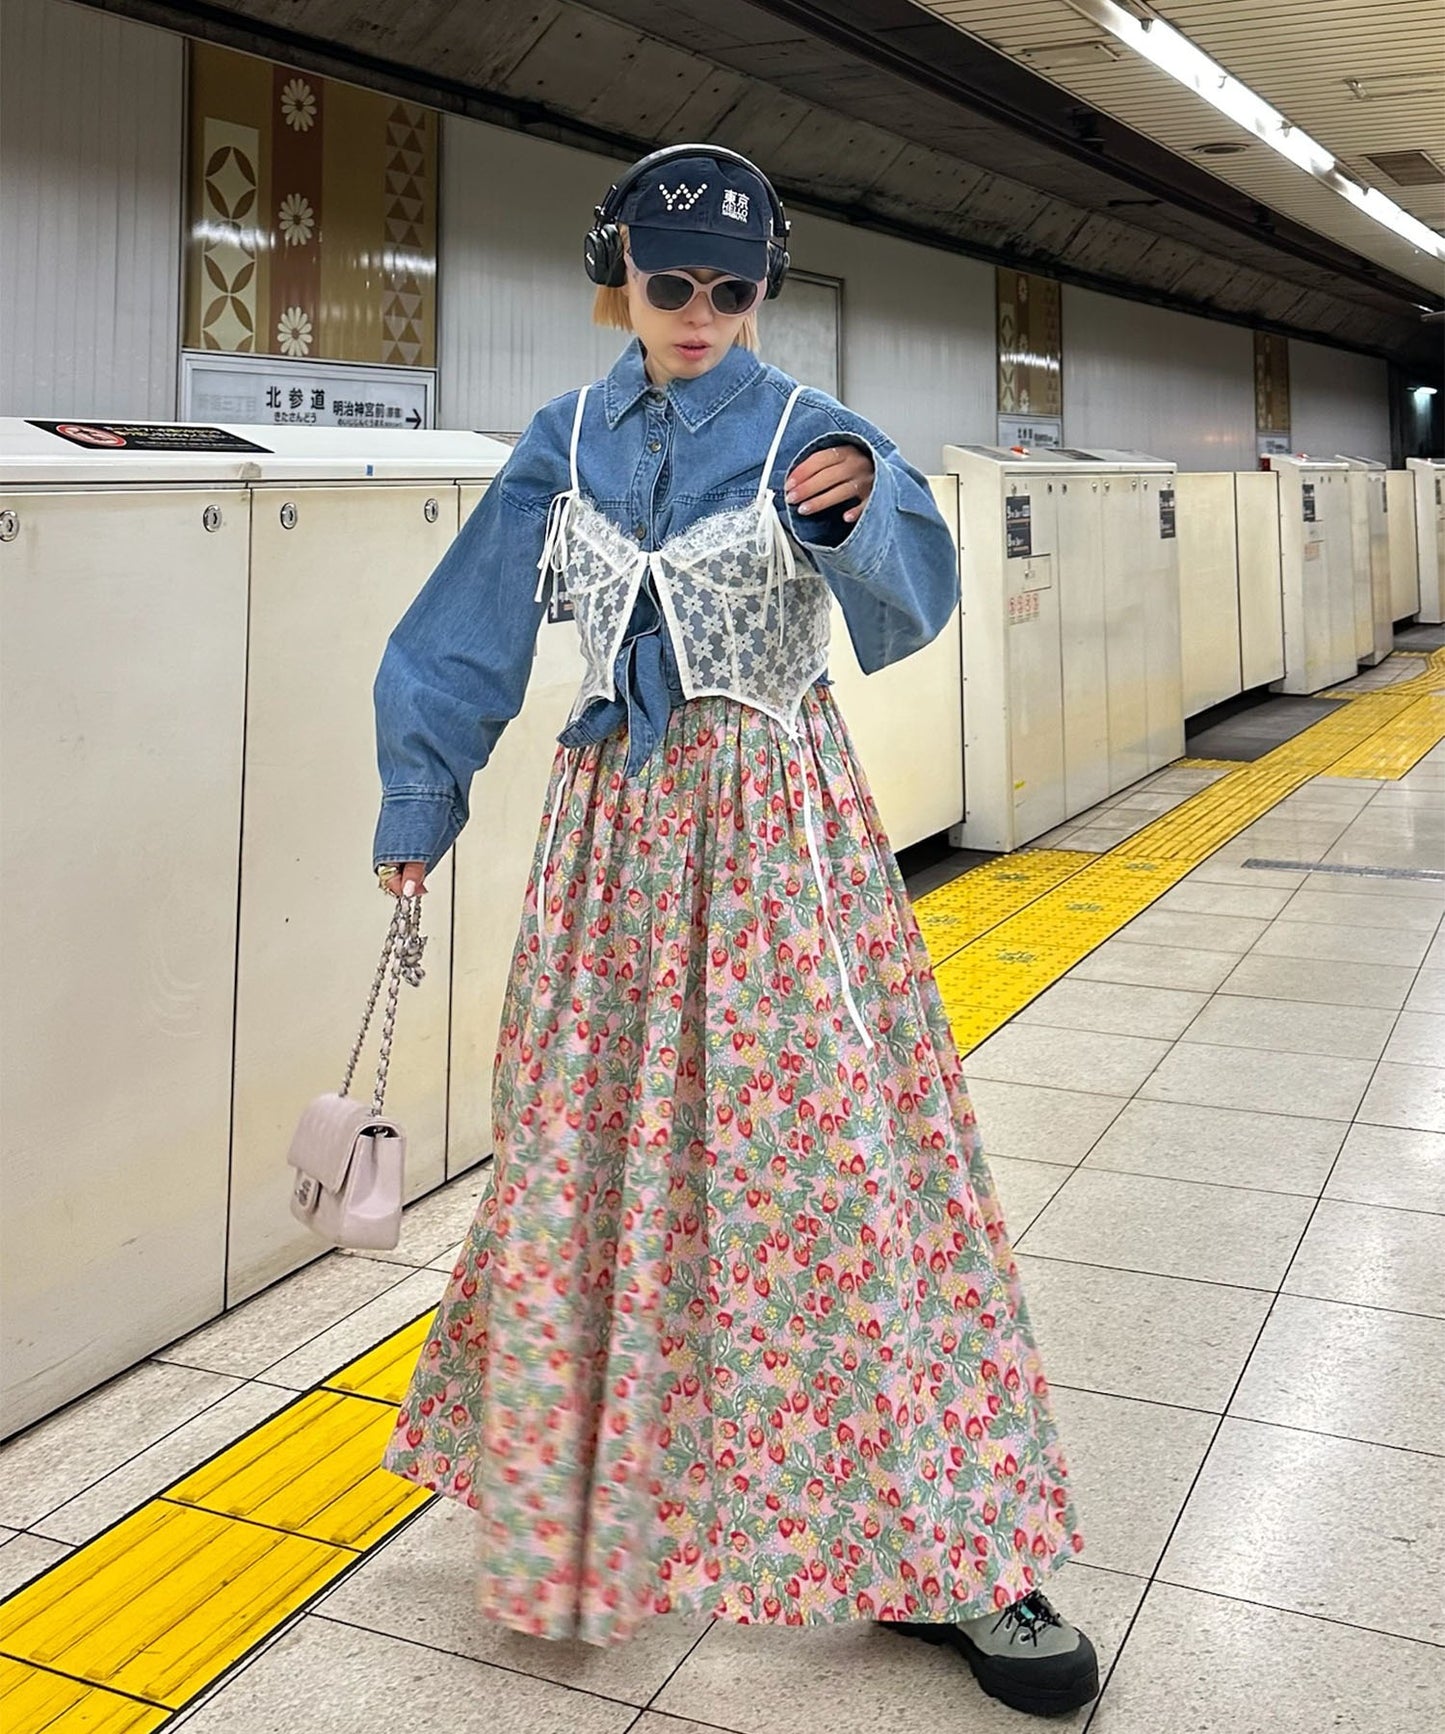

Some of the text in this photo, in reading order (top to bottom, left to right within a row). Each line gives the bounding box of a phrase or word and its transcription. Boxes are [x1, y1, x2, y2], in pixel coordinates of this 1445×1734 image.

[724, 189, 750, 210] 東京
[266, 386, 325, 410] 北参道
[274, 411, 317, 423] きたさんどう
